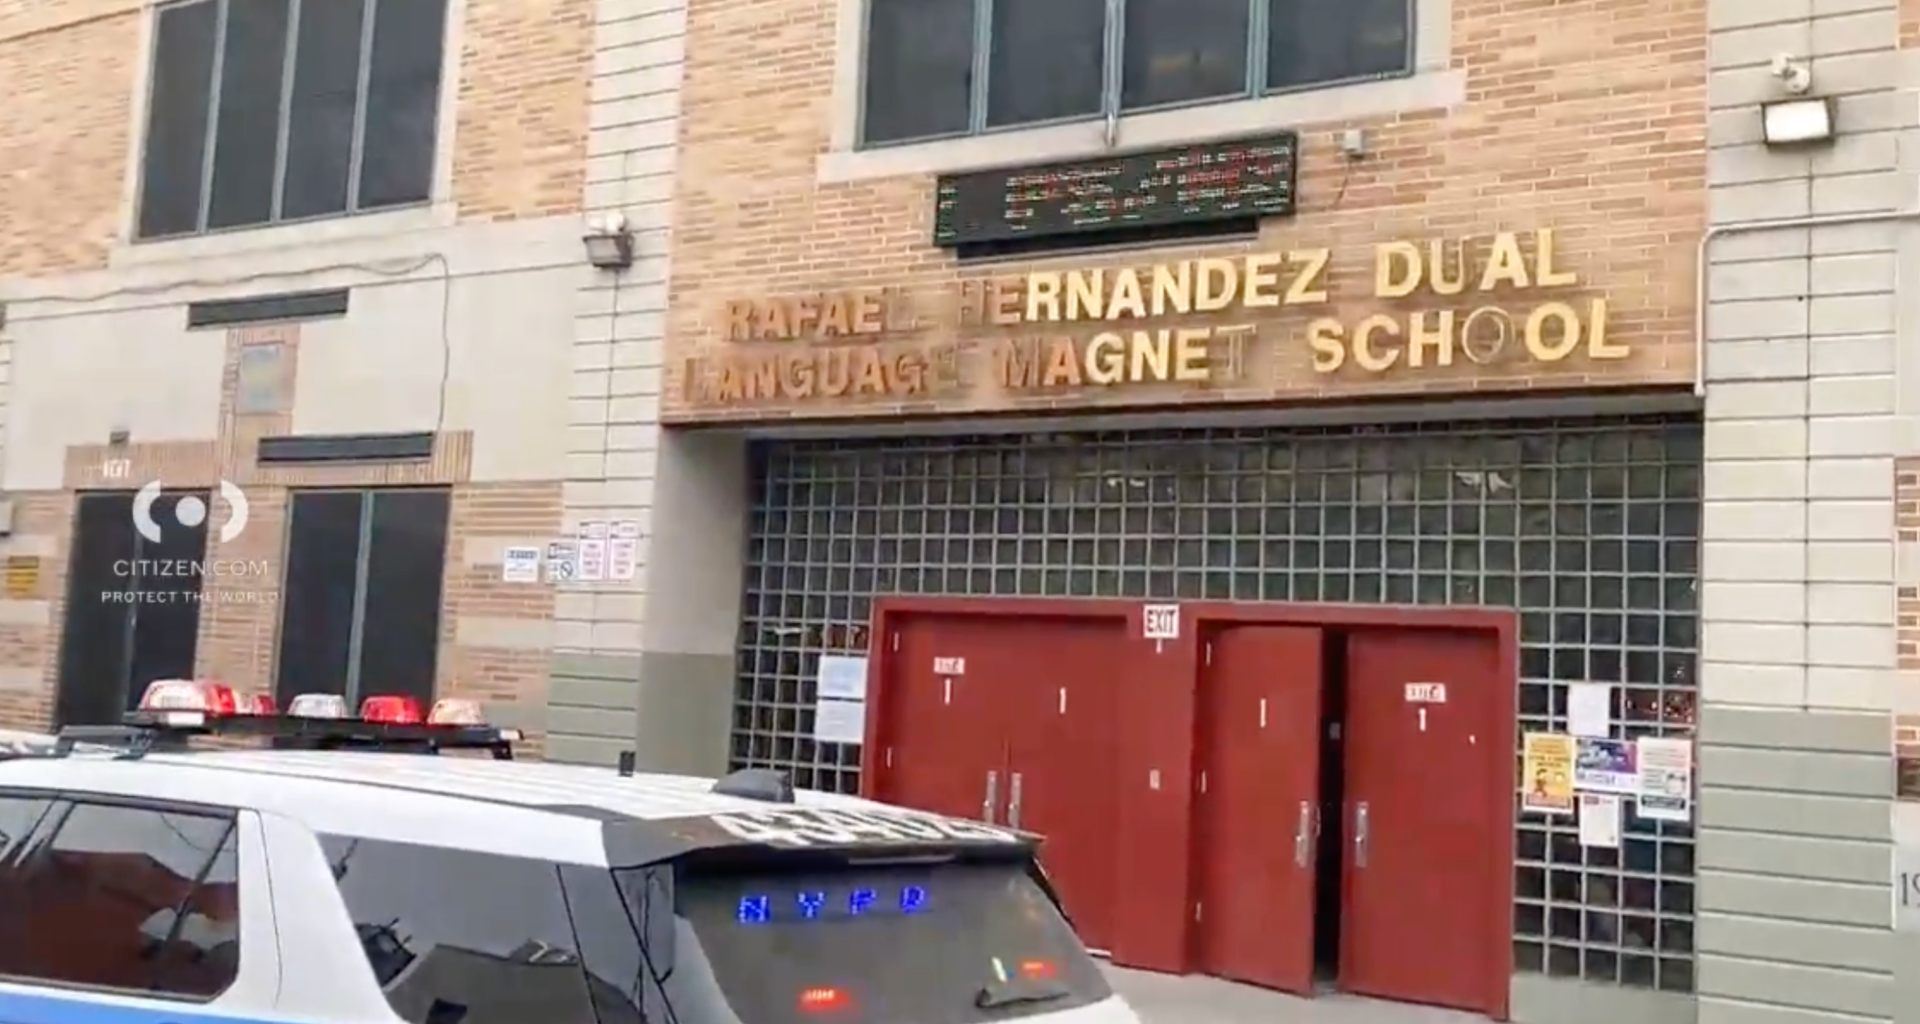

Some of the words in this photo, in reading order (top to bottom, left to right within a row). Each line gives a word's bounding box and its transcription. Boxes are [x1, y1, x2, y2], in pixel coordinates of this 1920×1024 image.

[725, 287, 914, 341] RAFAEL
[959, 249, 1331, 325] HERNANDEZ
[1375, 228, 1577, 298] DUAL
[1001, 324, 1256, 388] MAGNET
[1306, 298, 1630, 373] SCHOOL
[1147, 609, 1176, 633] EXIT
[738, 886, 925, 923] NYPD
